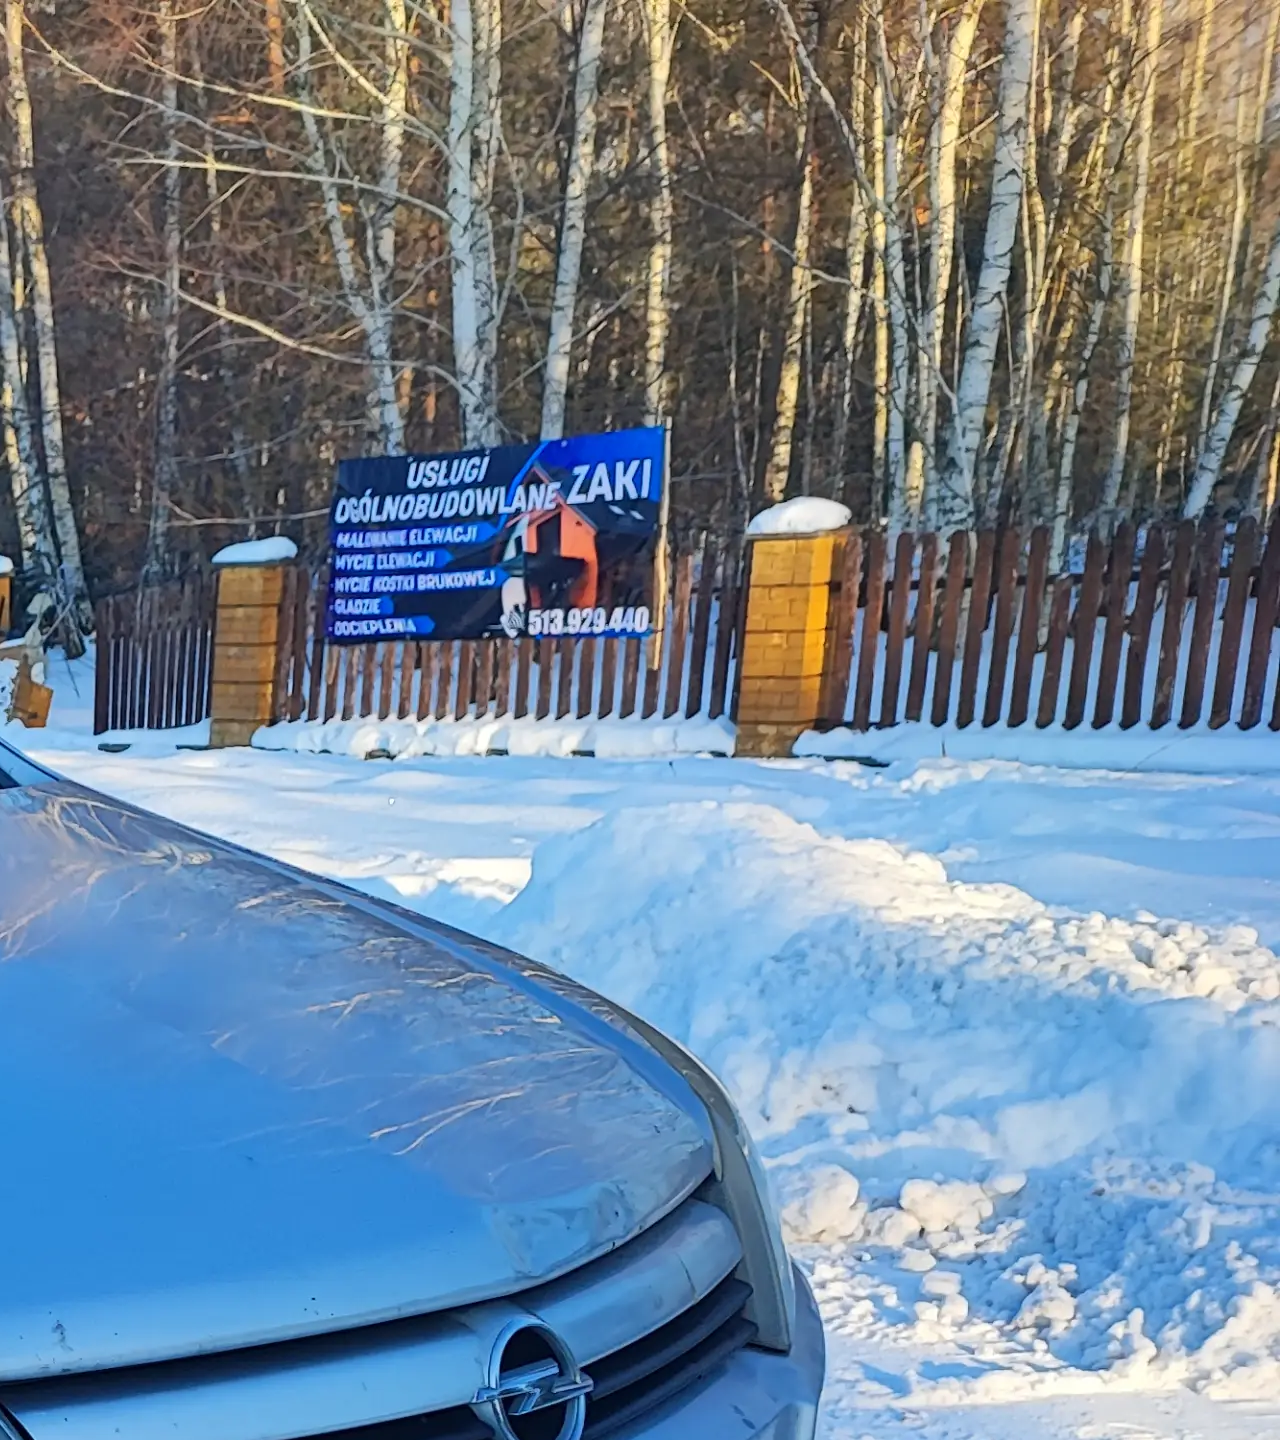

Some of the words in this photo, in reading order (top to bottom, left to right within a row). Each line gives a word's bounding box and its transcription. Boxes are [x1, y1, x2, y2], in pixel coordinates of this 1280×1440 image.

[407, 454, 490, 488] USŁUGI
[566, 459, 652, 505] ZAKI
[334, 482, 561, 524] OGÓLNOBUDOWLANE
[409, 526, 478, 545] ELEWACJI
[335, 553, 375, 571] MYCIE
[376, 551, 435, 570] ELEWACJI
[334, 576, 372, 593] MYCIE
[373, 574, 415, 592] KOSTKI
[417, 569, 496, 590] BRUKOWEJ
[527, 605, 649, 636] 513.929.440
